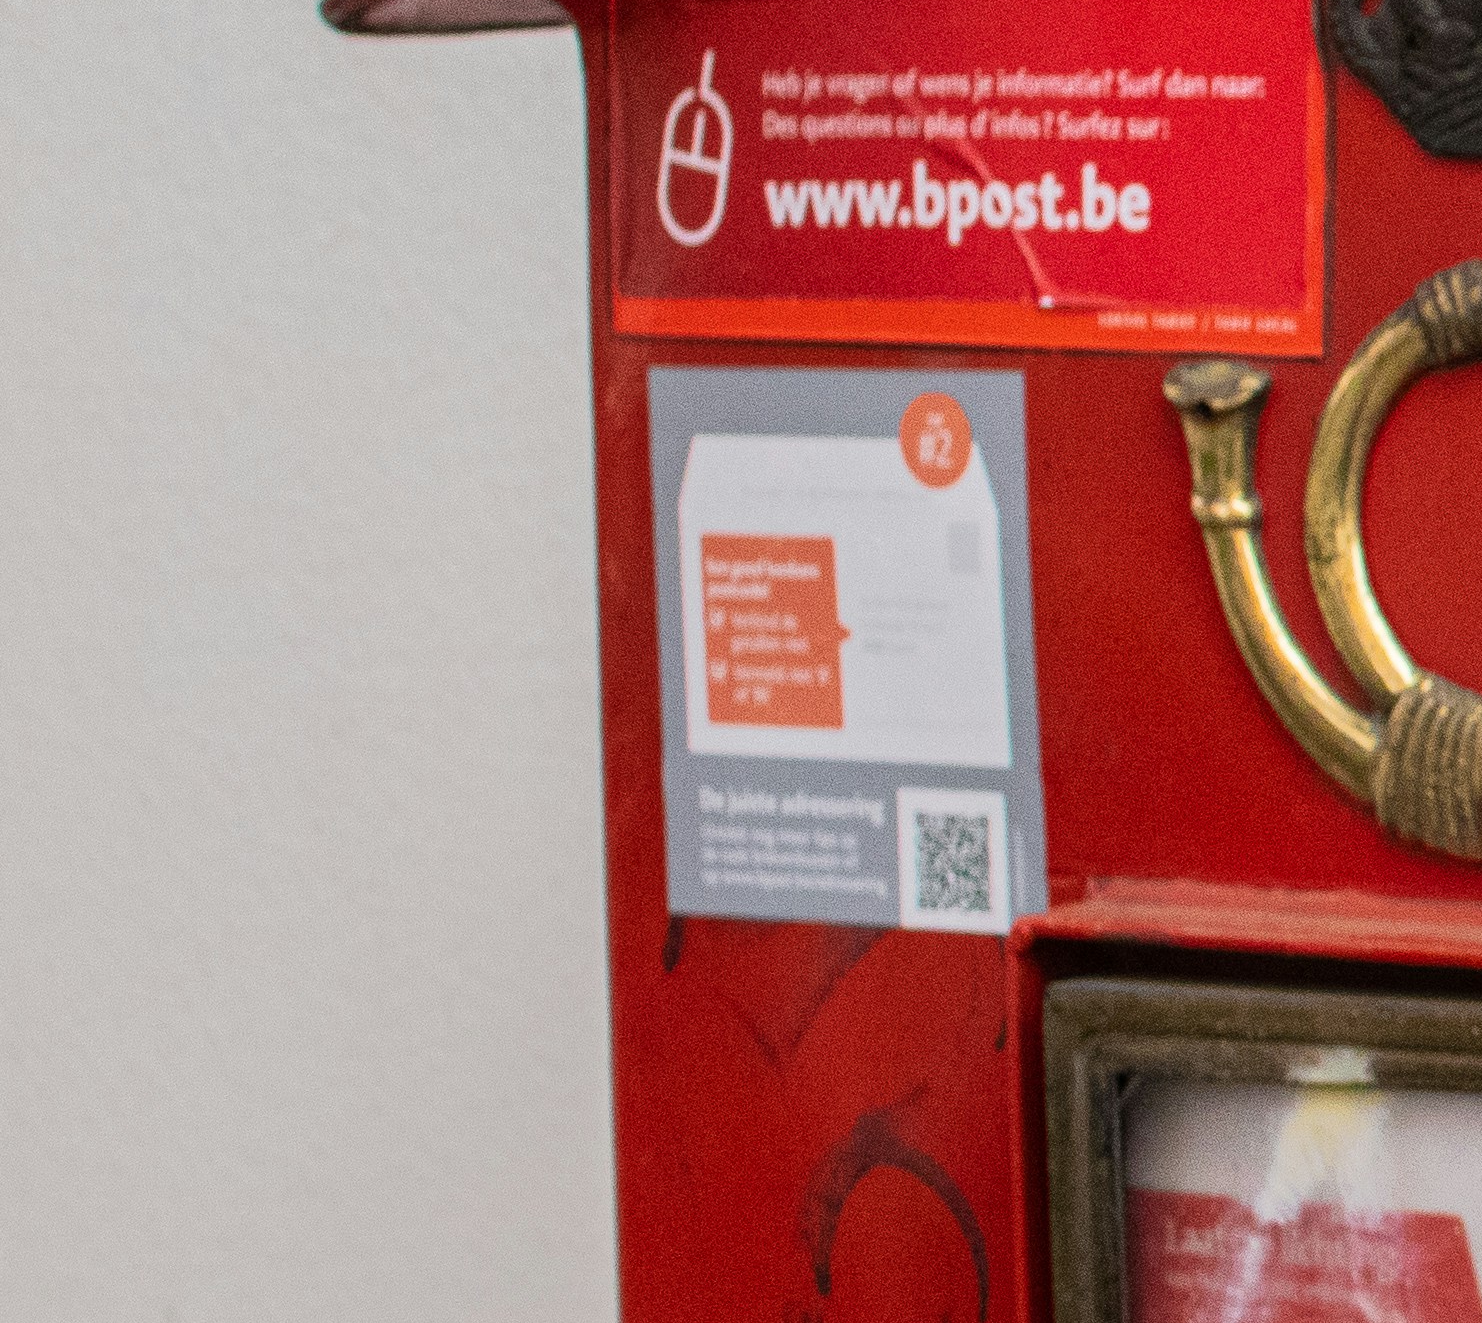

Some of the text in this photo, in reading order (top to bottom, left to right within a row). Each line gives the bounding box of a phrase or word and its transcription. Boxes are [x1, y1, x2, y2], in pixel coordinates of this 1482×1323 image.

[892, 66, 918, 98] of
[1116, 66, 1163, 99] Surf
[1164, 66, 1208, 99] dan
[761, 109, 798, 140] Des
[800, 107, 892, 145] questions
[763, 156, 1152, 247] www.bpost.be
